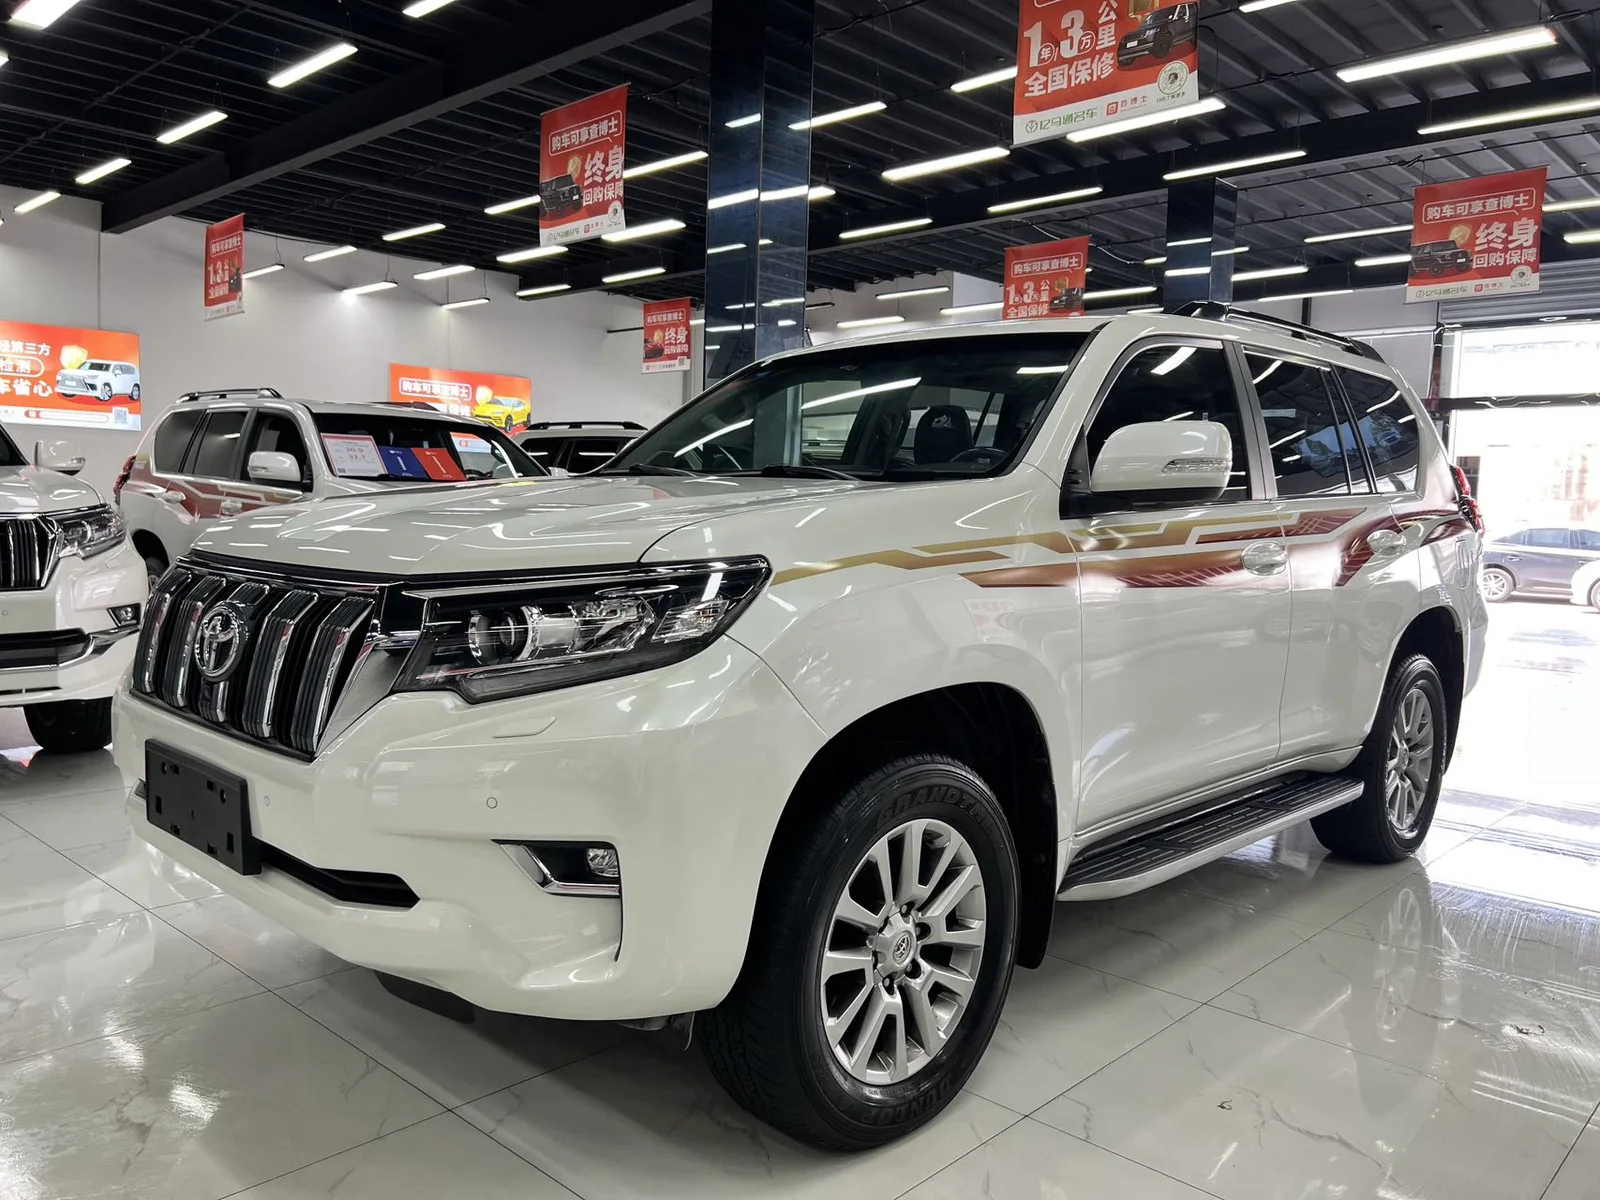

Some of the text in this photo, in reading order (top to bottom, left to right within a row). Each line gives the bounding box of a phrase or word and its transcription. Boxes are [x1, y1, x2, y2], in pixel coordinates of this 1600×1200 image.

[1024, 52, 1114, 97] 全国保修
[551, 117, 618, 152] 购车可享查博士
[584, 145, 624, 186] 终身
[582, 179, 624, 207] 回购保障
[1426, 193, 1529, 220] 购车可享查博士
[1475, 217, 1538, 251] 终身
[1472, 247, 1537, 269] 回购保障
[1006, 302, 1049, 319] 全国保修
[664, 326, 688, 344] 终身
